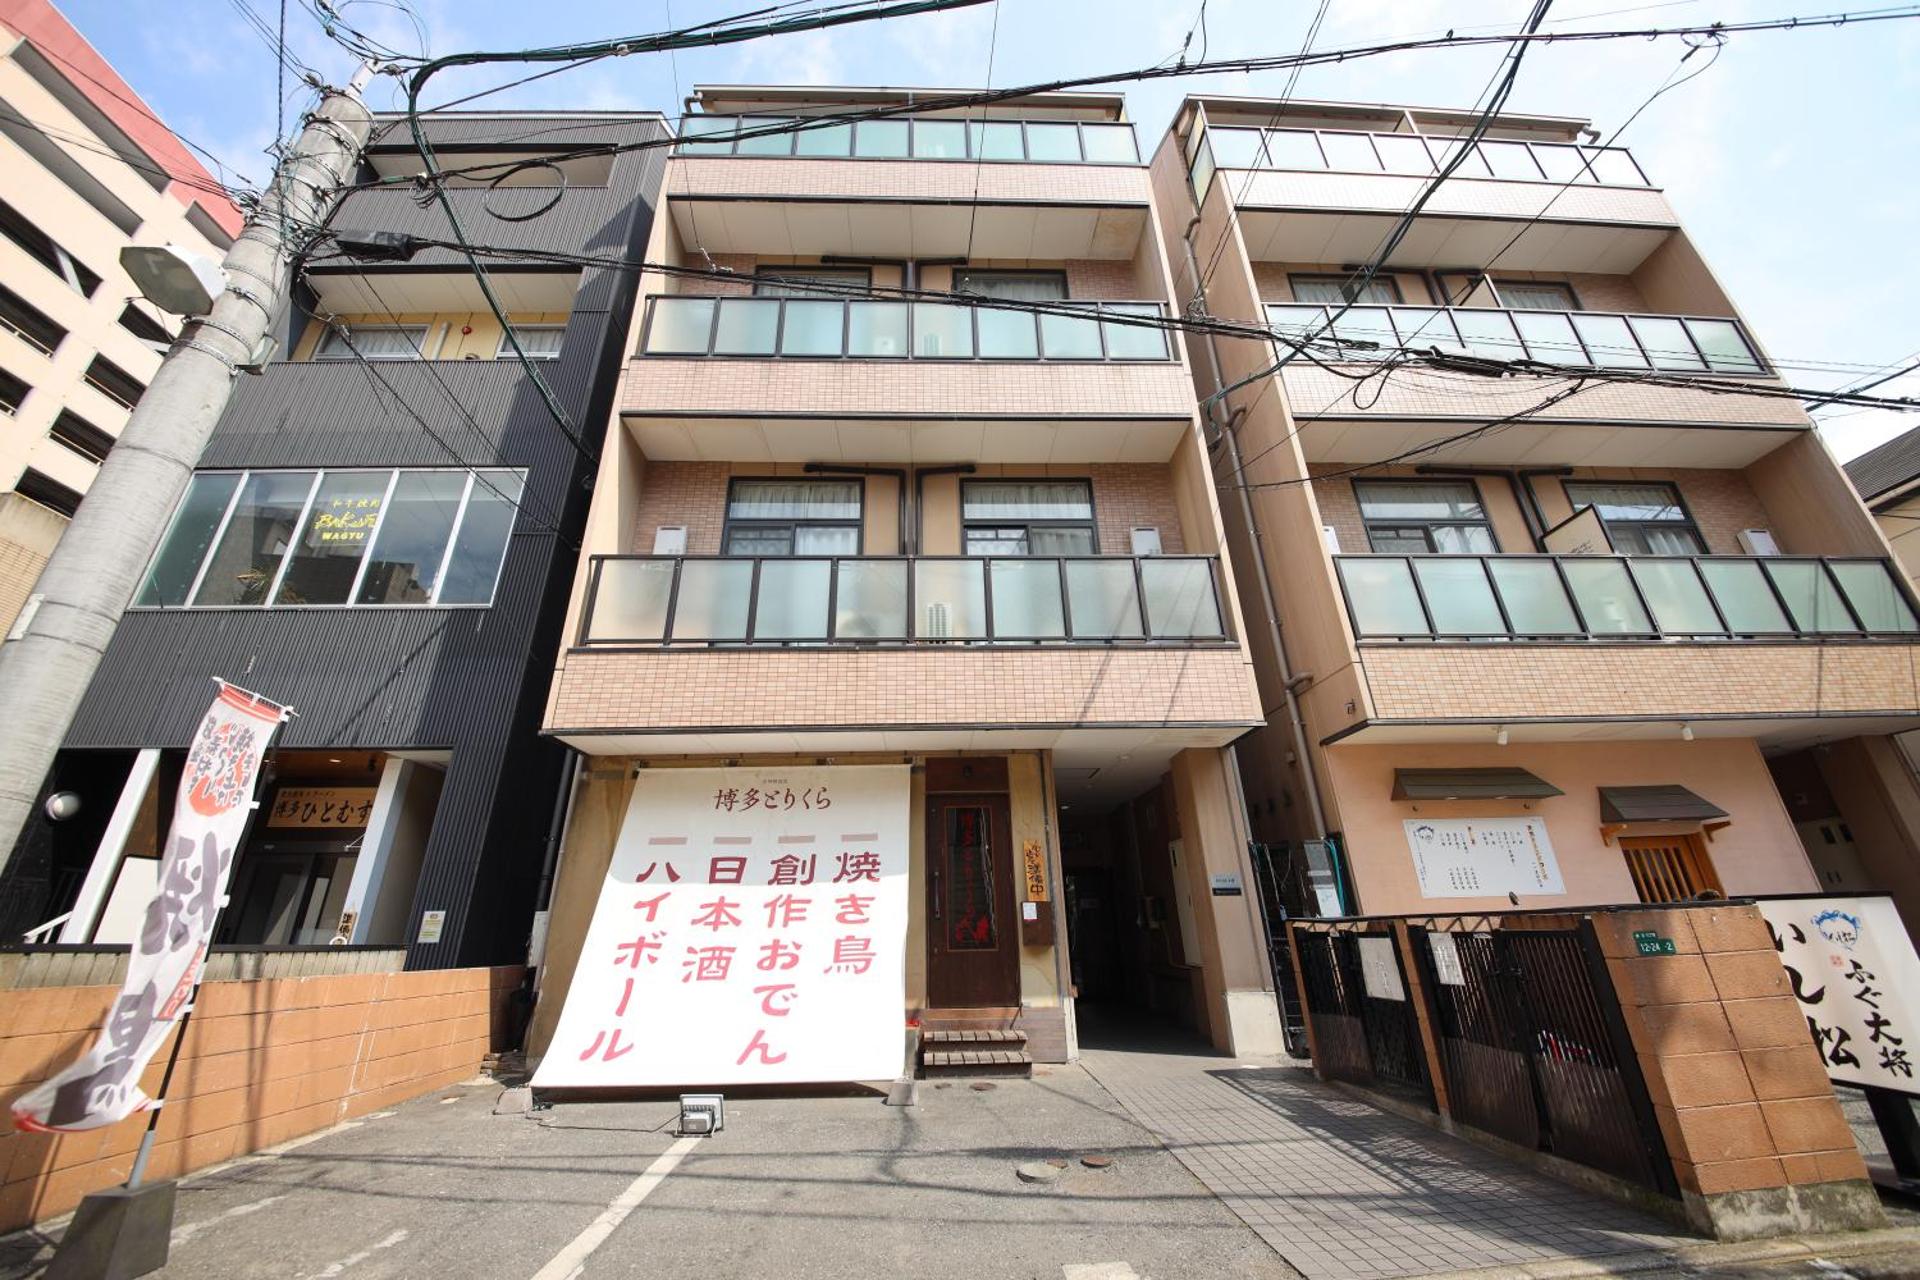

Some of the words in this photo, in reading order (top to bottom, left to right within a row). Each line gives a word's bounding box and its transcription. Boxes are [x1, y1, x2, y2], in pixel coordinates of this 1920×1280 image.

[322, 532, 364, 540] WAGYU
[713, 786, 831, 812] 博多とりくら
[579, 860, 681, 1062] ハイボール
[681, 856, 747, 983] 日本酒
[736, 853, 816, 1065] 創作おでん
[823, 852, 881, 975] 焼き鳥
[1845, 959, 1913, 1078] ふぐ大将
